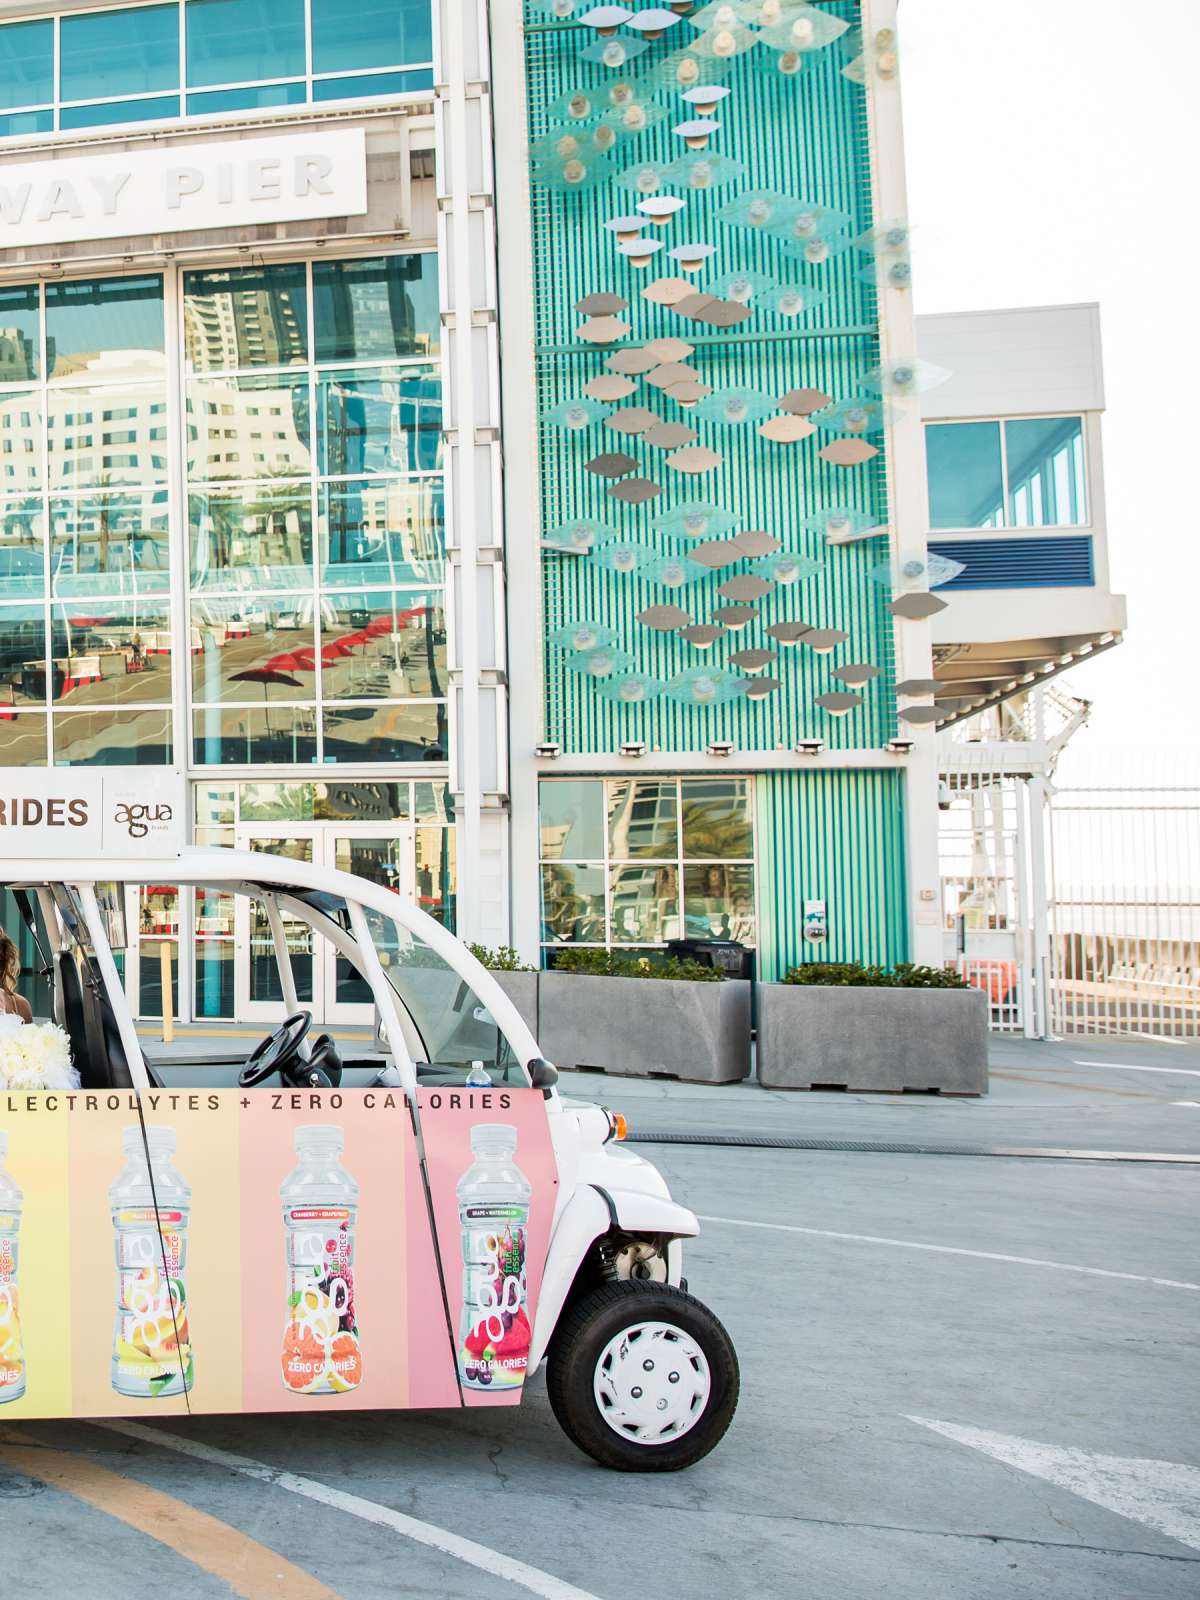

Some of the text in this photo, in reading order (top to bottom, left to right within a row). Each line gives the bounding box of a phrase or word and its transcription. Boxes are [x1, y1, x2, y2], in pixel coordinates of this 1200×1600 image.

[165, 152, 337, 210] PIER
[114, 803, 173, 838] agua
[271, 1093, 344, 1110] ZERO
[362, 1092, 513, 1110] CALORIES
[287, 1359, 357, 1373] ZERO CARIES
[464, 1357, 528, 1370] ZERO CALORIES
